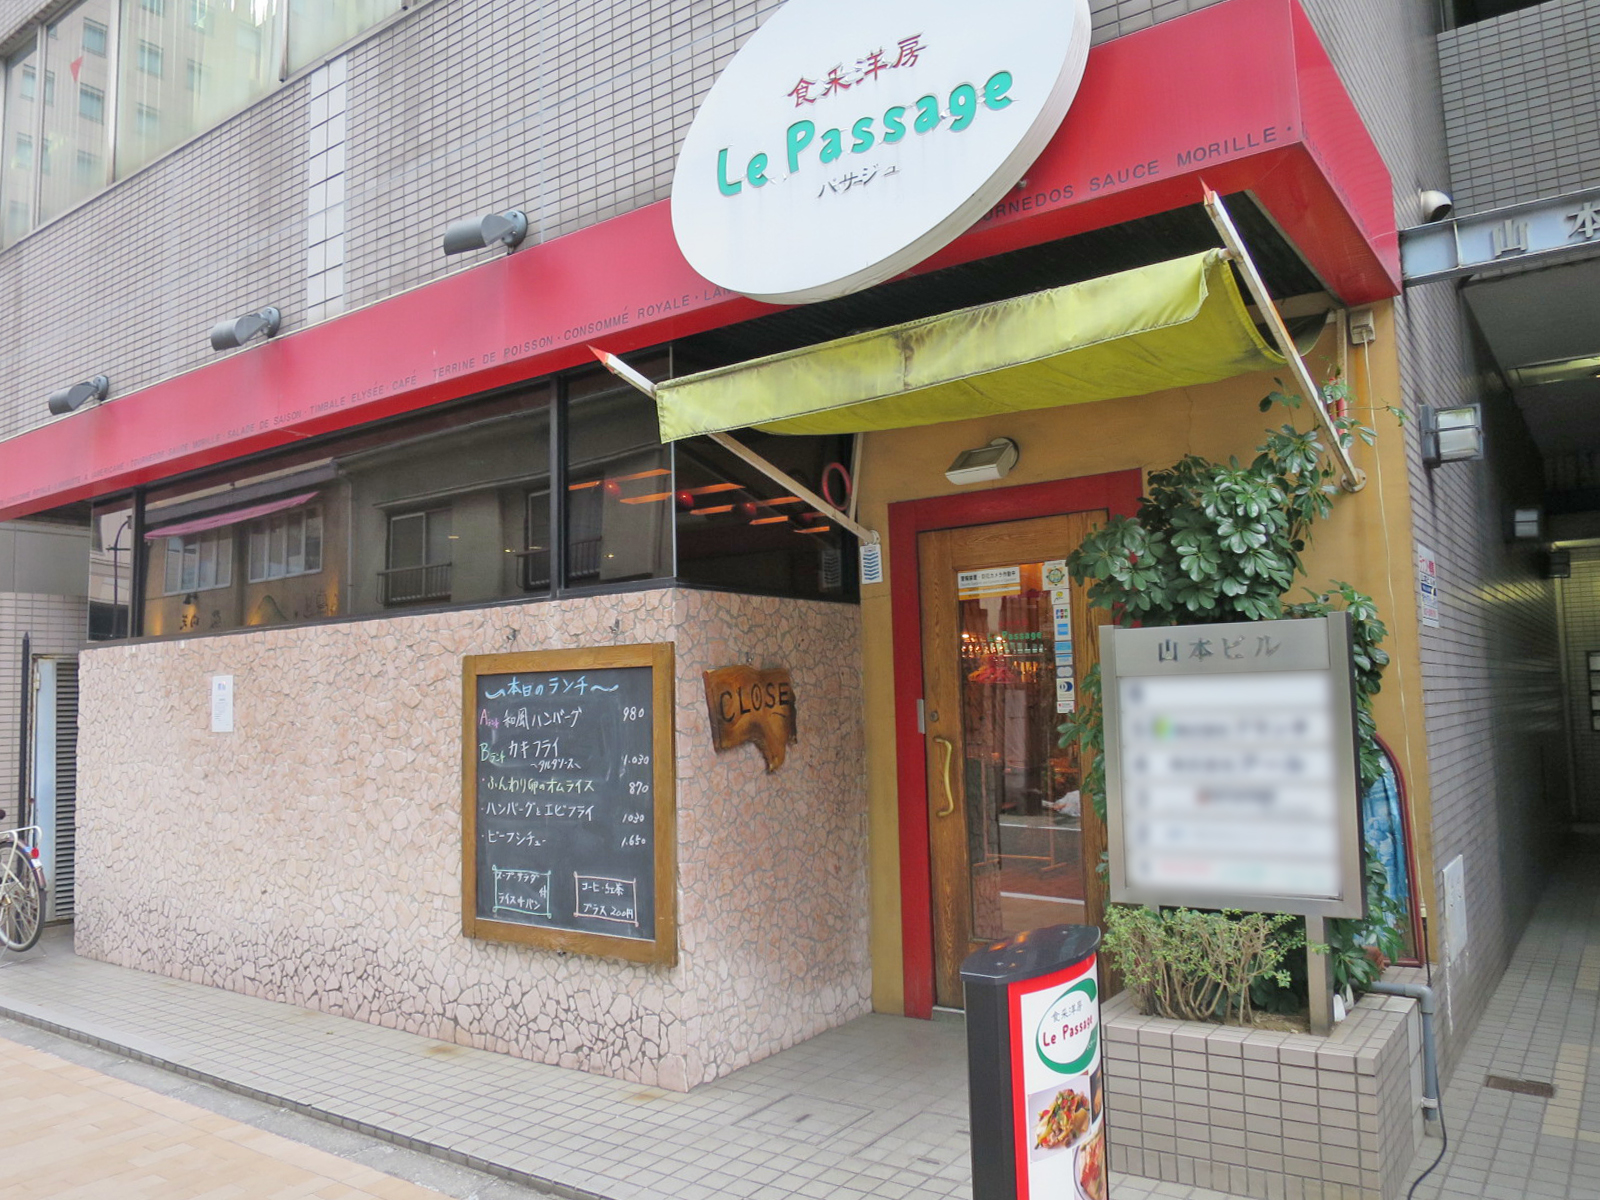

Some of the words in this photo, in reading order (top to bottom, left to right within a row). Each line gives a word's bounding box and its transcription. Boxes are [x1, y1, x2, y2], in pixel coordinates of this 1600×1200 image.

[716, 146, 769, 197] Le
[786, 69, 1017, 175] Passage
[1088, 159, 1160, 192] SAUCE
[1176, 126, 1278, 168] MORILLE
[818, 164, 899, 198] パサージュ
[1490, 201, 1600, 259] 山本
[259, 419, 270, 430] DE
[273, 409, 302, 426] SAISON
[309, 396, 346, 415] TIMBALE
[391, 369, 417, 391] CAFÉ
[432, 357, 475, 379] TERRINE
[482, 352, 496, 364] DE
[503, 335, 553, 359] POISSON
[564, 306, 629, 341] CONSOMMÉ
[637, 295, 690, 320] ROYALE
[1001, 630, 1042, 641] Passage
[1158, 635, 1282, 663] 山本ビル
[719, 682, 790, 723] CLOSE
[502, 706, 583, 730] 和風ハンバーグ
[623, 706, 645, 722] 980
[508, 736, 560, 759] カキフライ
[628, 781, 649, 795] 870
[622, 812, 645, 824] 1030
[1042, 1031, 1057, 1047] Le
